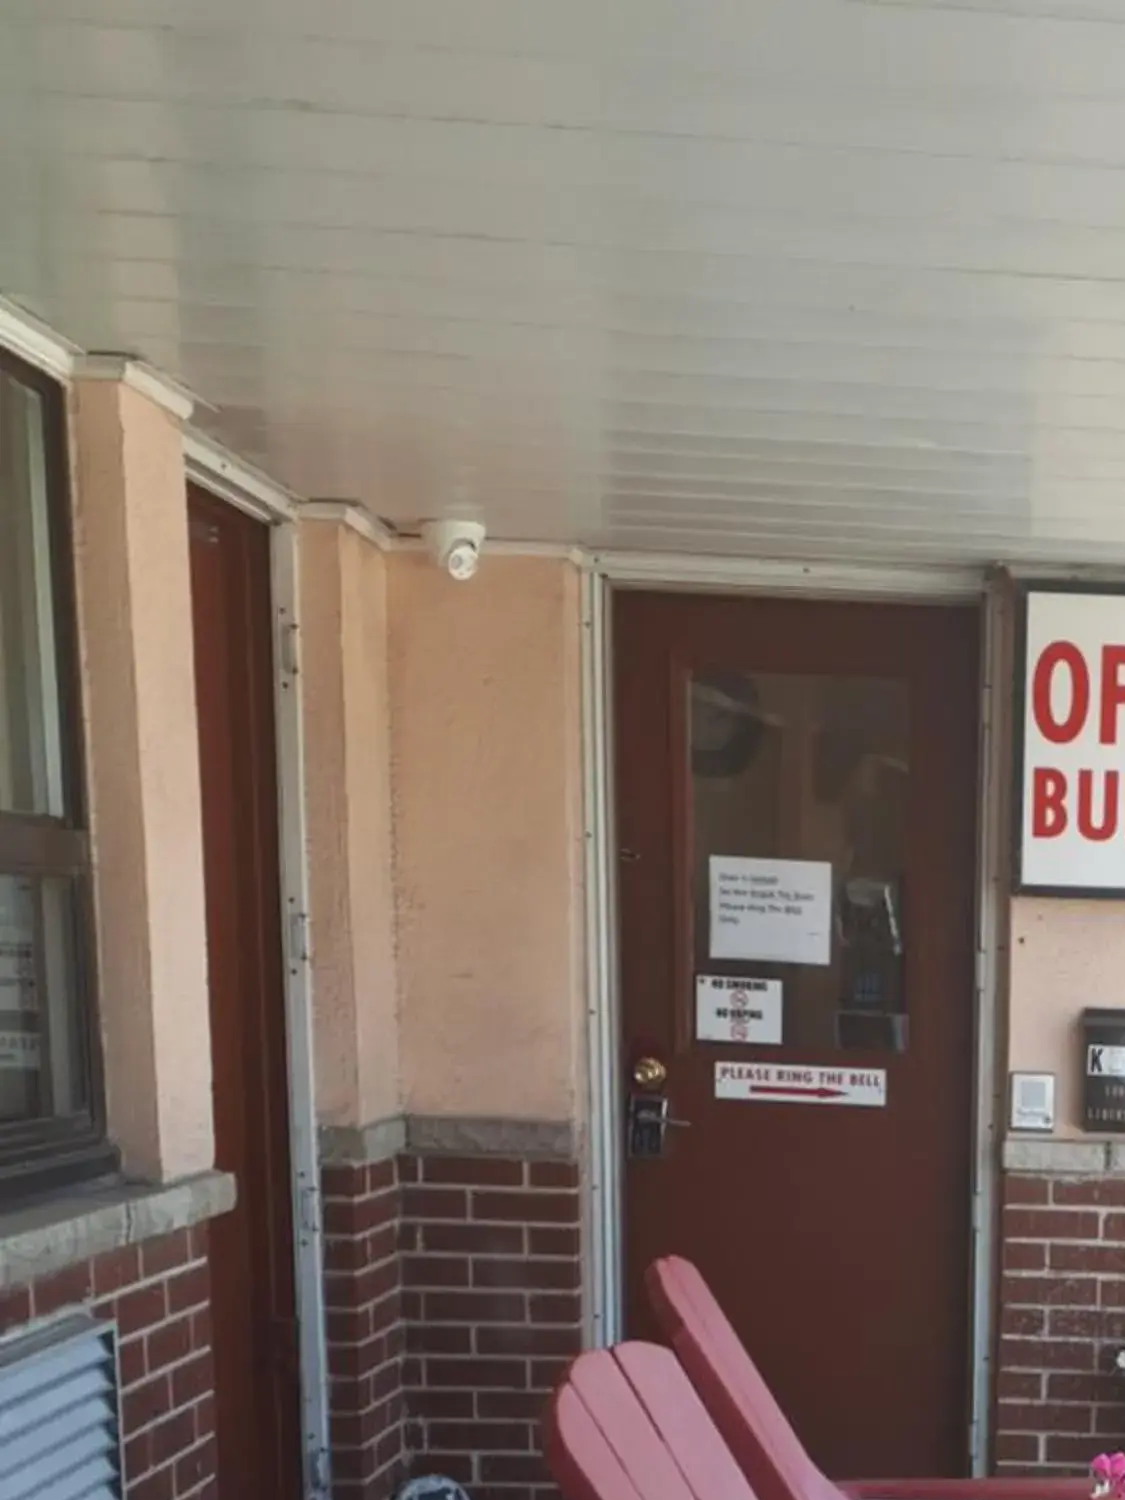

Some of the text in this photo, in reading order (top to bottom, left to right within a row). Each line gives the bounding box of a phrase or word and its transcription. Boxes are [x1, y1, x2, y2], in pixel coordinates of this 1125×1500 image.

[719, 1066, 880, 1088] PLEASE RING THE BELL
